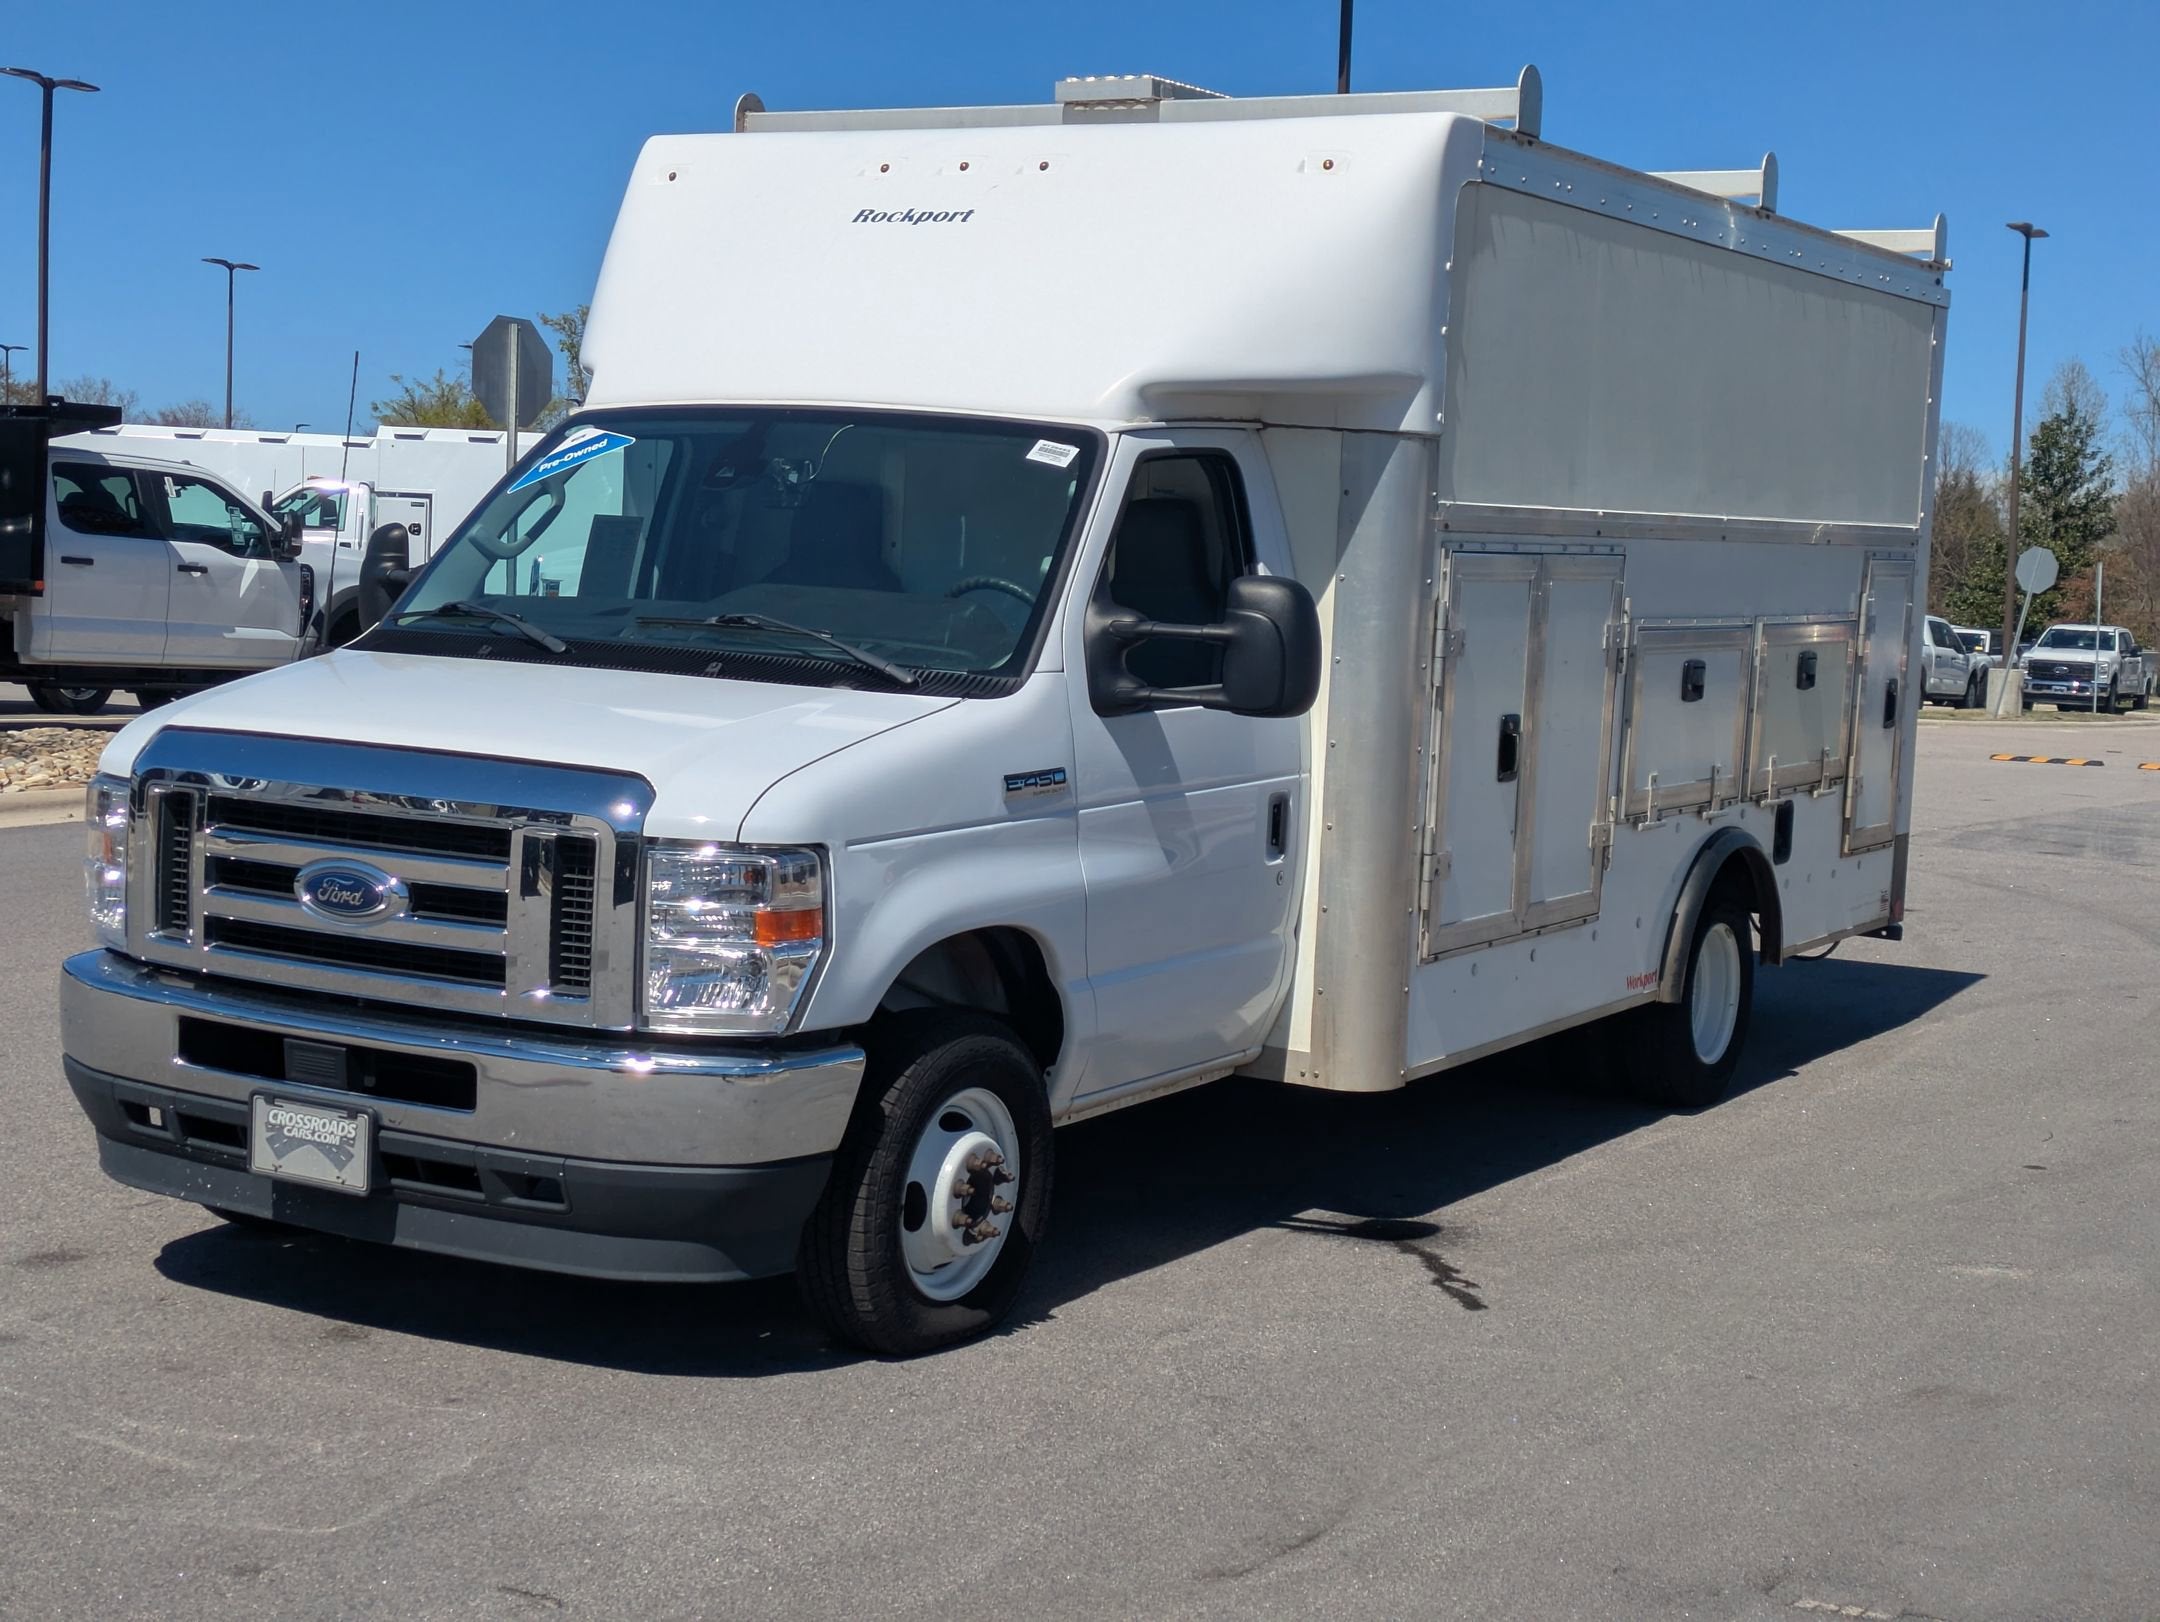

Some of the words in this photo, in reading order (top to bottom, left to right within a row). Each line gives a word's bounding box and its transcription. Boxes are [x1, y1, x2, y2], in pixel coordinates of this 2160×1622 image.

[851, 208, 975, 225] Rockport
[539, 438, 608, 473] Pre-Owned
[316, 876, 365, 906] Ford
[268, 1109, 358, 1138] CROSSROADS
[283, 1126, 340, 1146] CARS.COM
